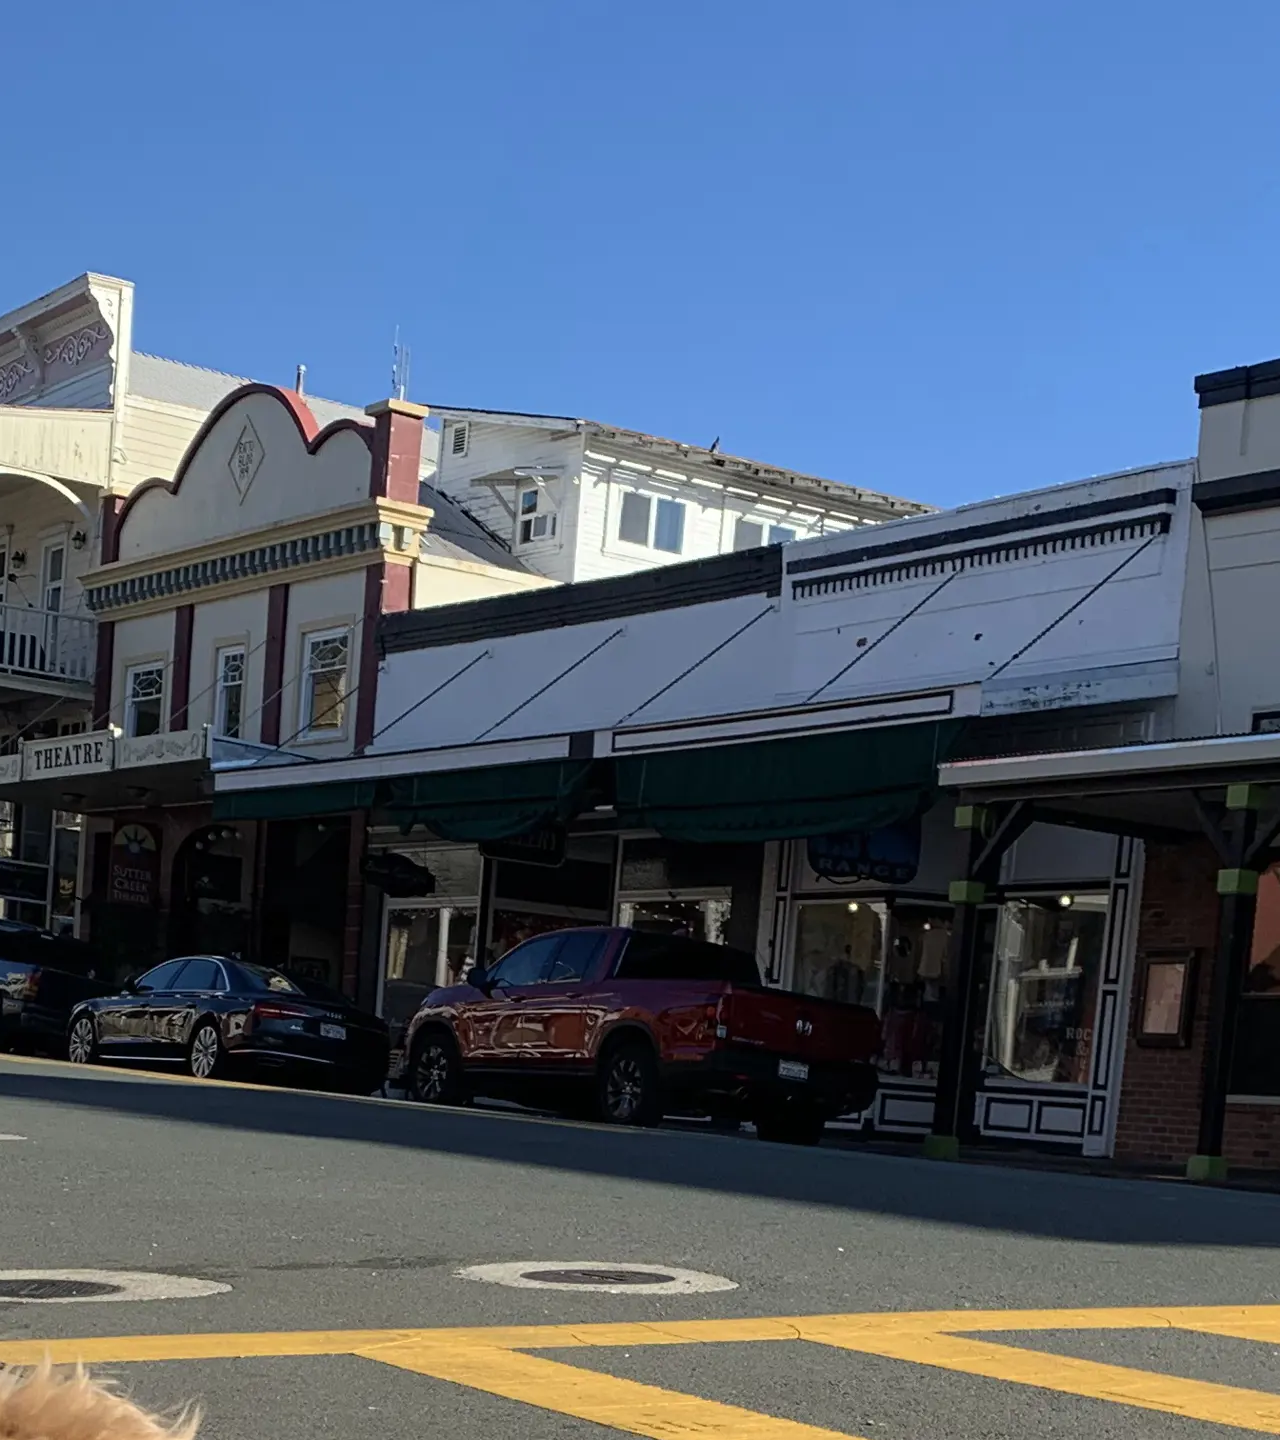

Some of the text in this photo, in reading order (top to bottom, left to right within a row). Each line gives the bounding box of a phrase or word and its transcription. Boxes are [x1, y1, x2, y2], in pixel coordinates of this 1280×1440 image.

[34, 742, 104, 771] THEATRE
[113, 864, 152, 882] SUTTER
[818, 857, 910, 879] RANGE
